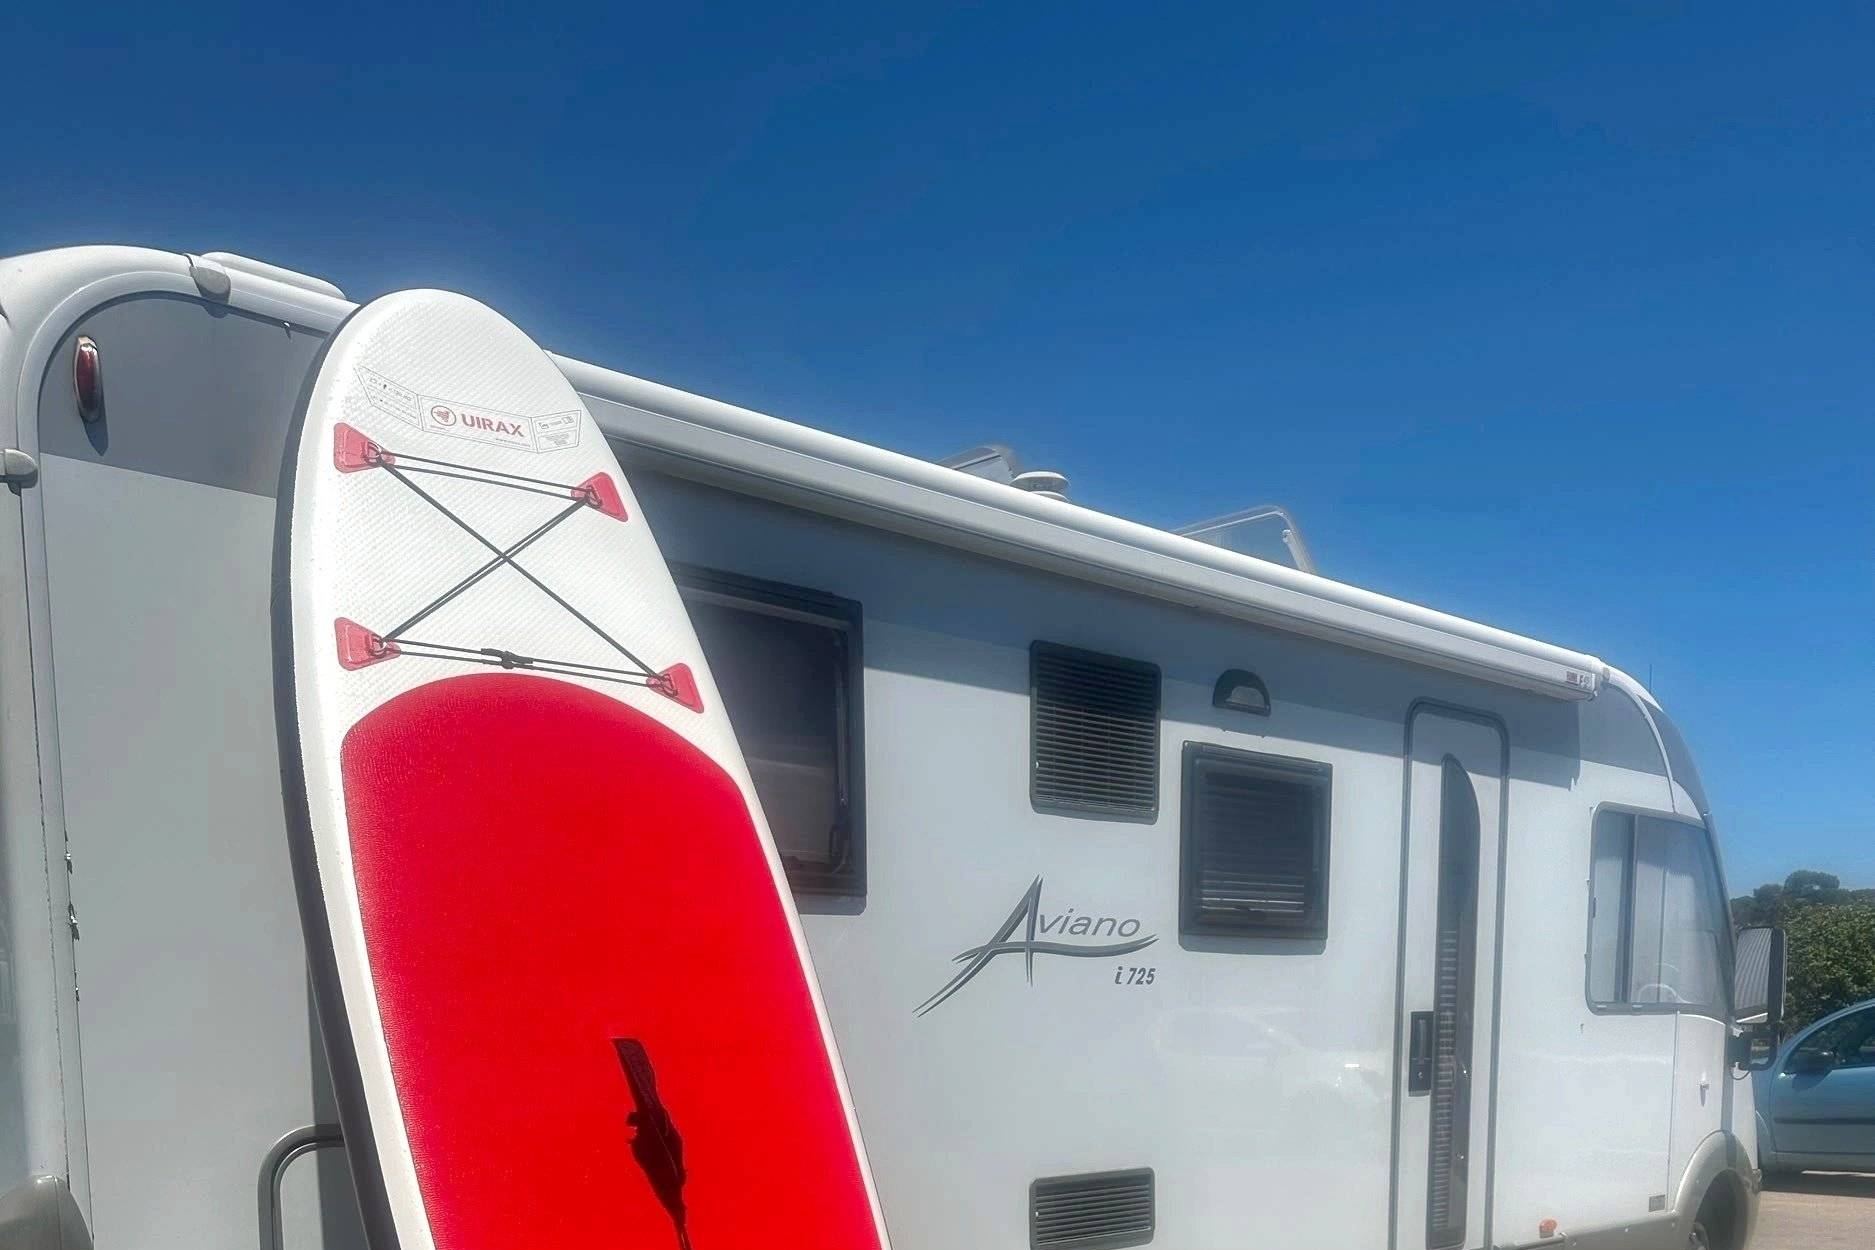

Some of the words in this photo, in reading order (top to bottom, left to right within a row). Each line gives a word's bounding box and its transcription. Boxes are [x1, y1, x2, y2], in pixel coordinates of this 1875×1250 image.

[461, 413, 524, 437] UIRAX
[912, 874, 1160, 1018] Aviano
[1126, 967, 1156, 985] 725
